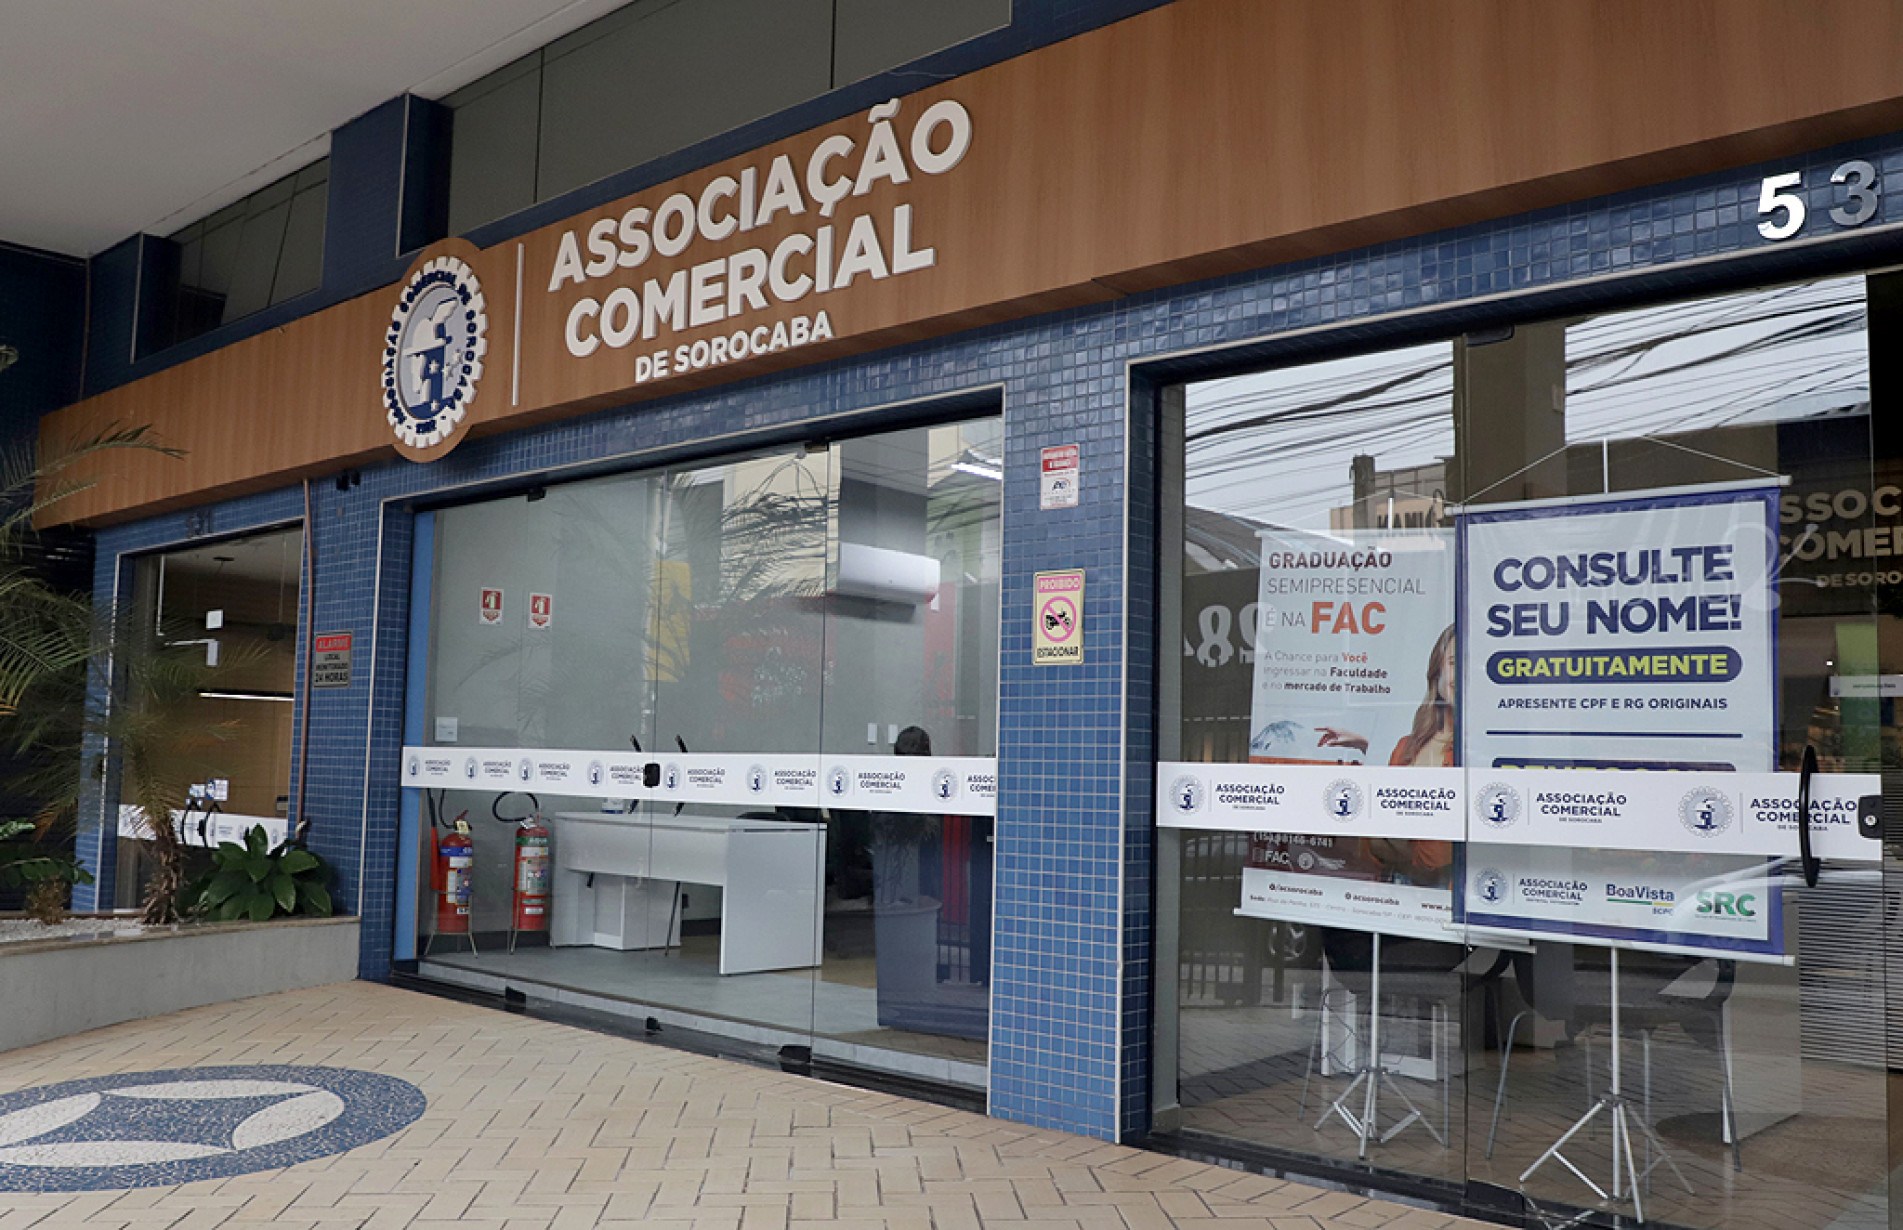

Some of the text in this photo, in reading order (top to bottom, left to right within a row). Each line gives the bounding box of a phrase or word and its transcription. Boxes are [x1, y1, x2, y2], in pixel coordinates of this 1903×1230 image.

[547, 98, 973, 293] ASSOCIAÇÃO
[564, 203, 937, 358] COMERCIAL
[634, 310, 835, 384] DE SOROCABA
[1268, 545, 1393, 572] GRADUAÇÃO
[1493, 544, 1735, 592] CONSULTE
[1266, 577, 1427, 596] SEMIPRESENCIAL
[1281, 611, 1306, 627] NA
[1311, 601, 1387, 636] FAC
[1486, 593, 1742, 638] SEU NOME!
[1274, 650, 1313, 661] Chance
[1315, 653, 1339, 664] para
[1341, 651, 1369, 664] Você
[1329, 666, 1388, 679] Faculdade
[1497, 653, 1729, 678] GRATUITAMENTE
[1283, 682, 1328, 692] mercado
[1328, 682, 1343, 693] de
[1344, 682, 1391, 695] Trabalho
[1497, 697, 1729, 710] APRESENTE CPF E RG ORIGINAIS
[1215, 782, 1285, 794] ASSOCIAÇÃO
[1376, 787, 1456, 800] ASSOCIAÇÃO
[1218, 794, 1280, 805] COMERCIAL
[1380, 799, 1451, 811] COMERCIAL
[1536, 790, 1627, 806] ASSOCIAÇÃO
[1750, 797, 1858, 812] ASSOCAÇÃO
[1540, 804, 1622, 817] COMERCIAL
[1264, 850, 1290, 865] FAC
[1518, 878, 1588, 892] ASSOCIAÇÃO
[1606, 883, 1675, 901] BoaVista
[1521, 887, 1584, 901] COMERCIAL
[1696, 890, 1756, 916] SRC
